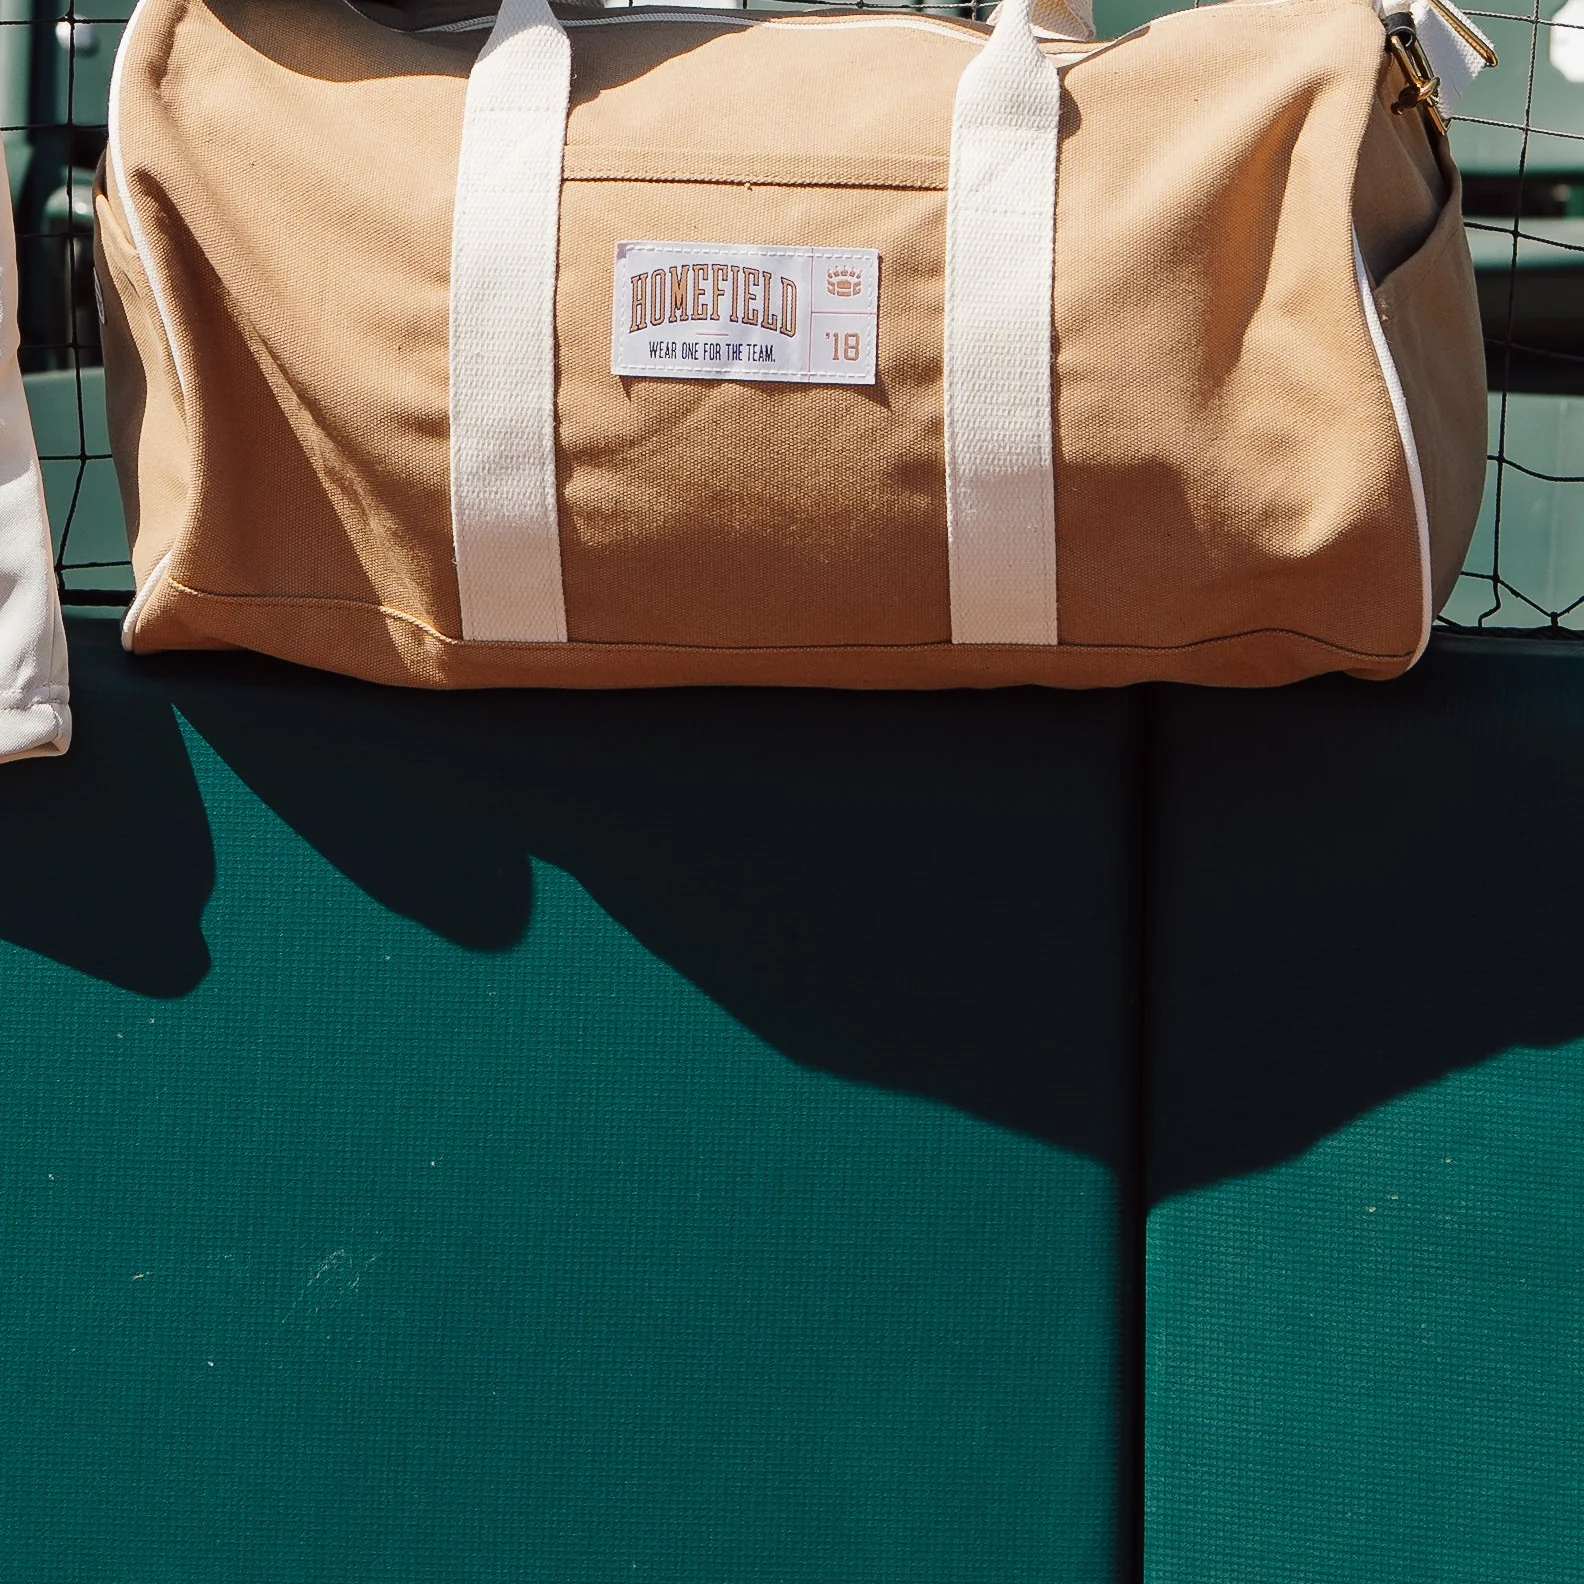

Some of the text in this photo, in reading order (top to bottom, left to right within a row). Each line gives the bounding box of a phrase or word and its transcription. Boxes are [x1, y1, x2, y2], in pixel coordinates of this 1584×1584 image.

[629, 263, 798, 338] HOMEFIELD
[648, 341, 776, 363] WEAR ONE FOR THE TEAM.
[825, 331, 861, 361] '18
